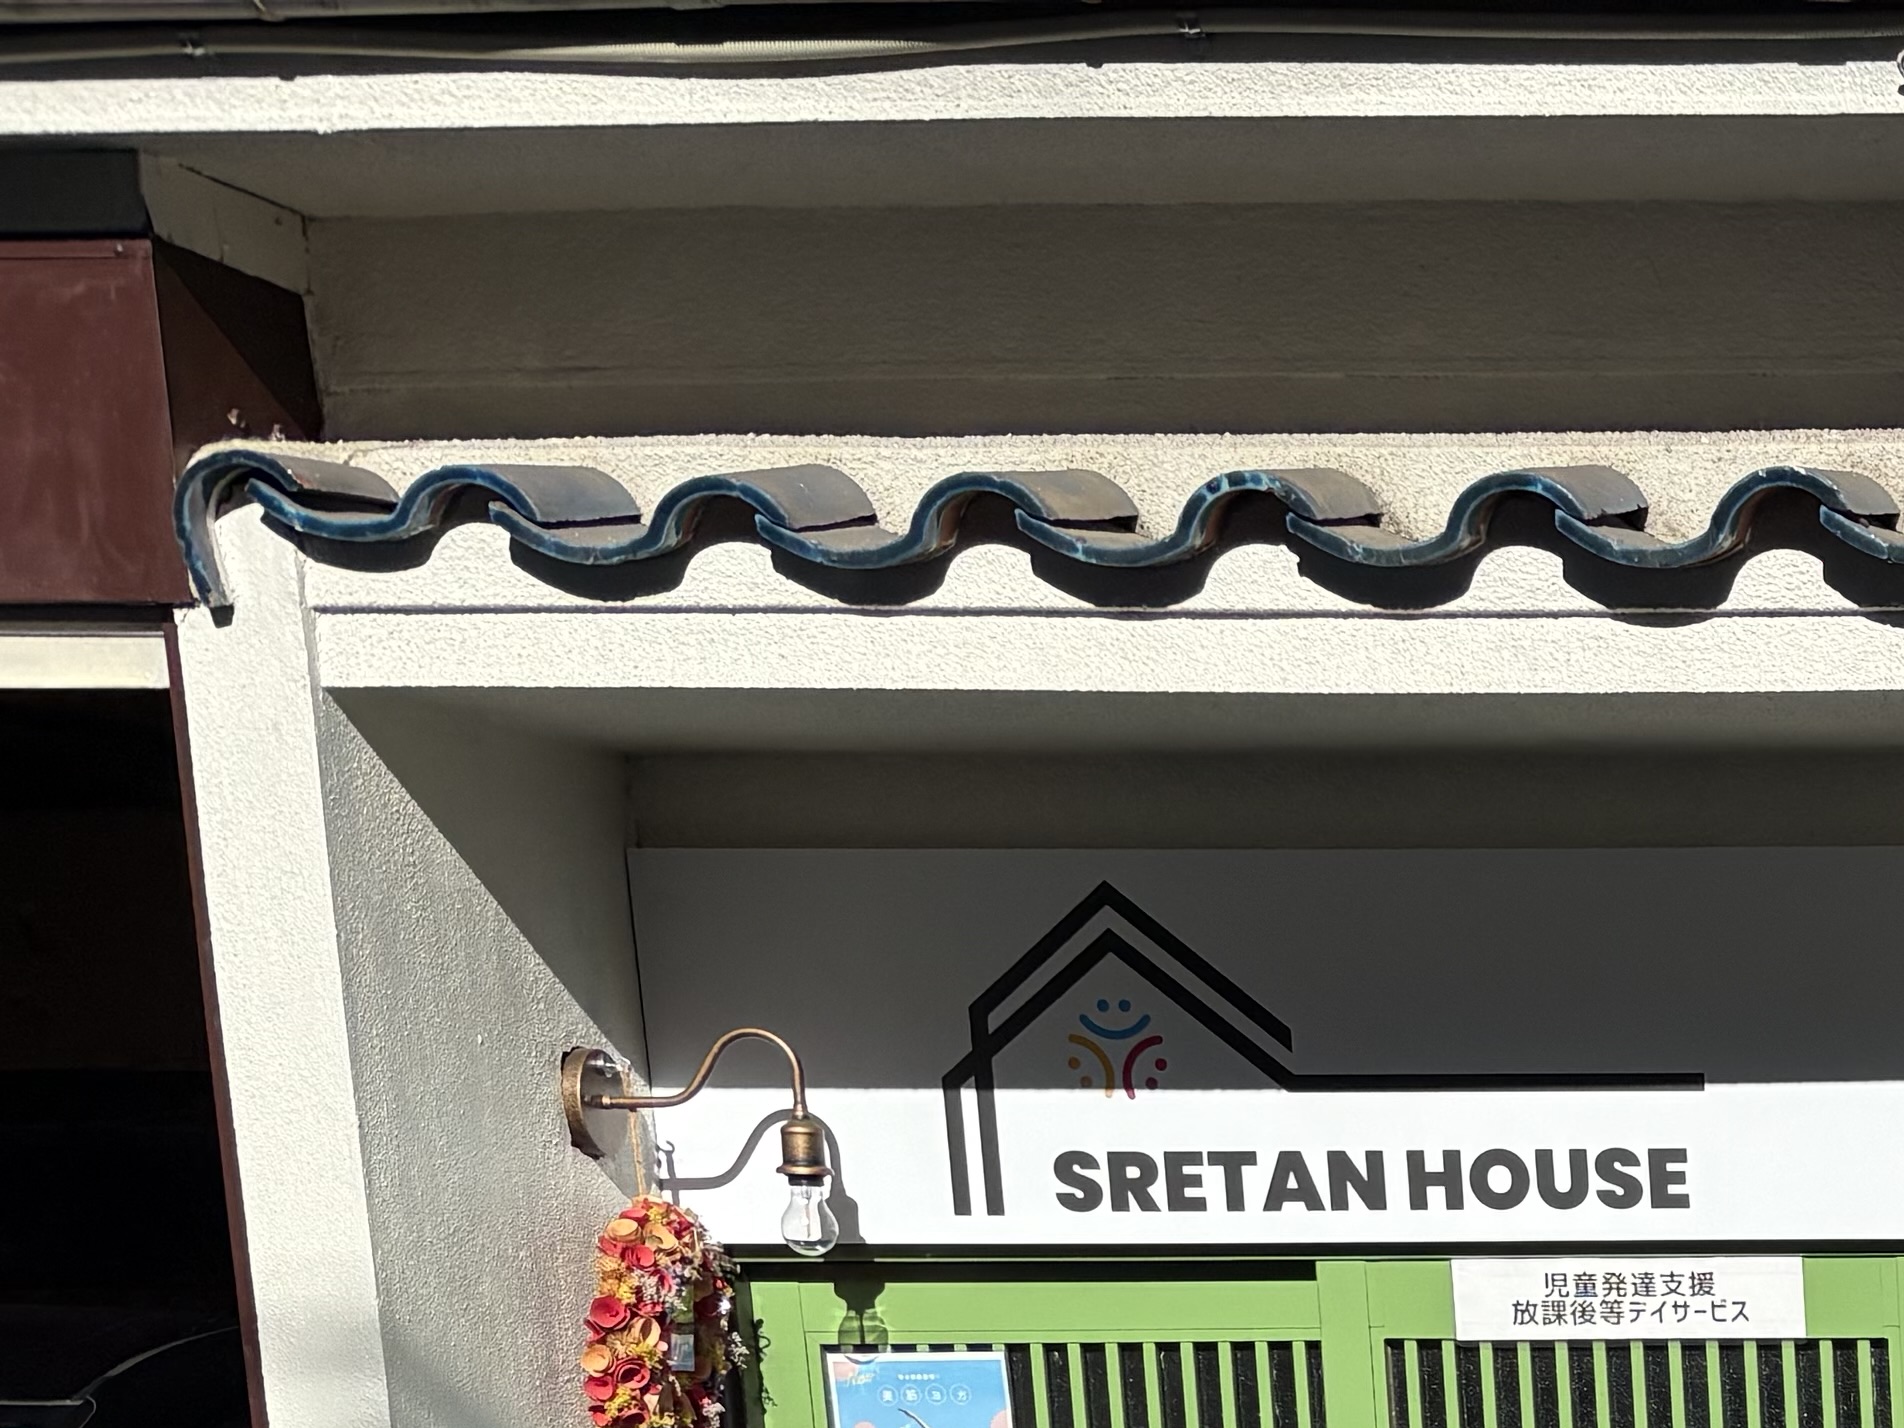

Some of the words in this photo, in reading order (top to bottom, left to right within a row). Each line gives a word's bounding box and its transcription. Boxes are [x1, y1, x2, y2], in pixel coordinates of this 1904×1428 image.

[1052, 1149, 1387, 1212] SRETAN
[1405, 1147, 1691, 1211] HOUSE
[1544, 1271, 1716, 1298] 児童発達支援
[1512, 1299, 1750, 1326] 放課後等デイサービス
